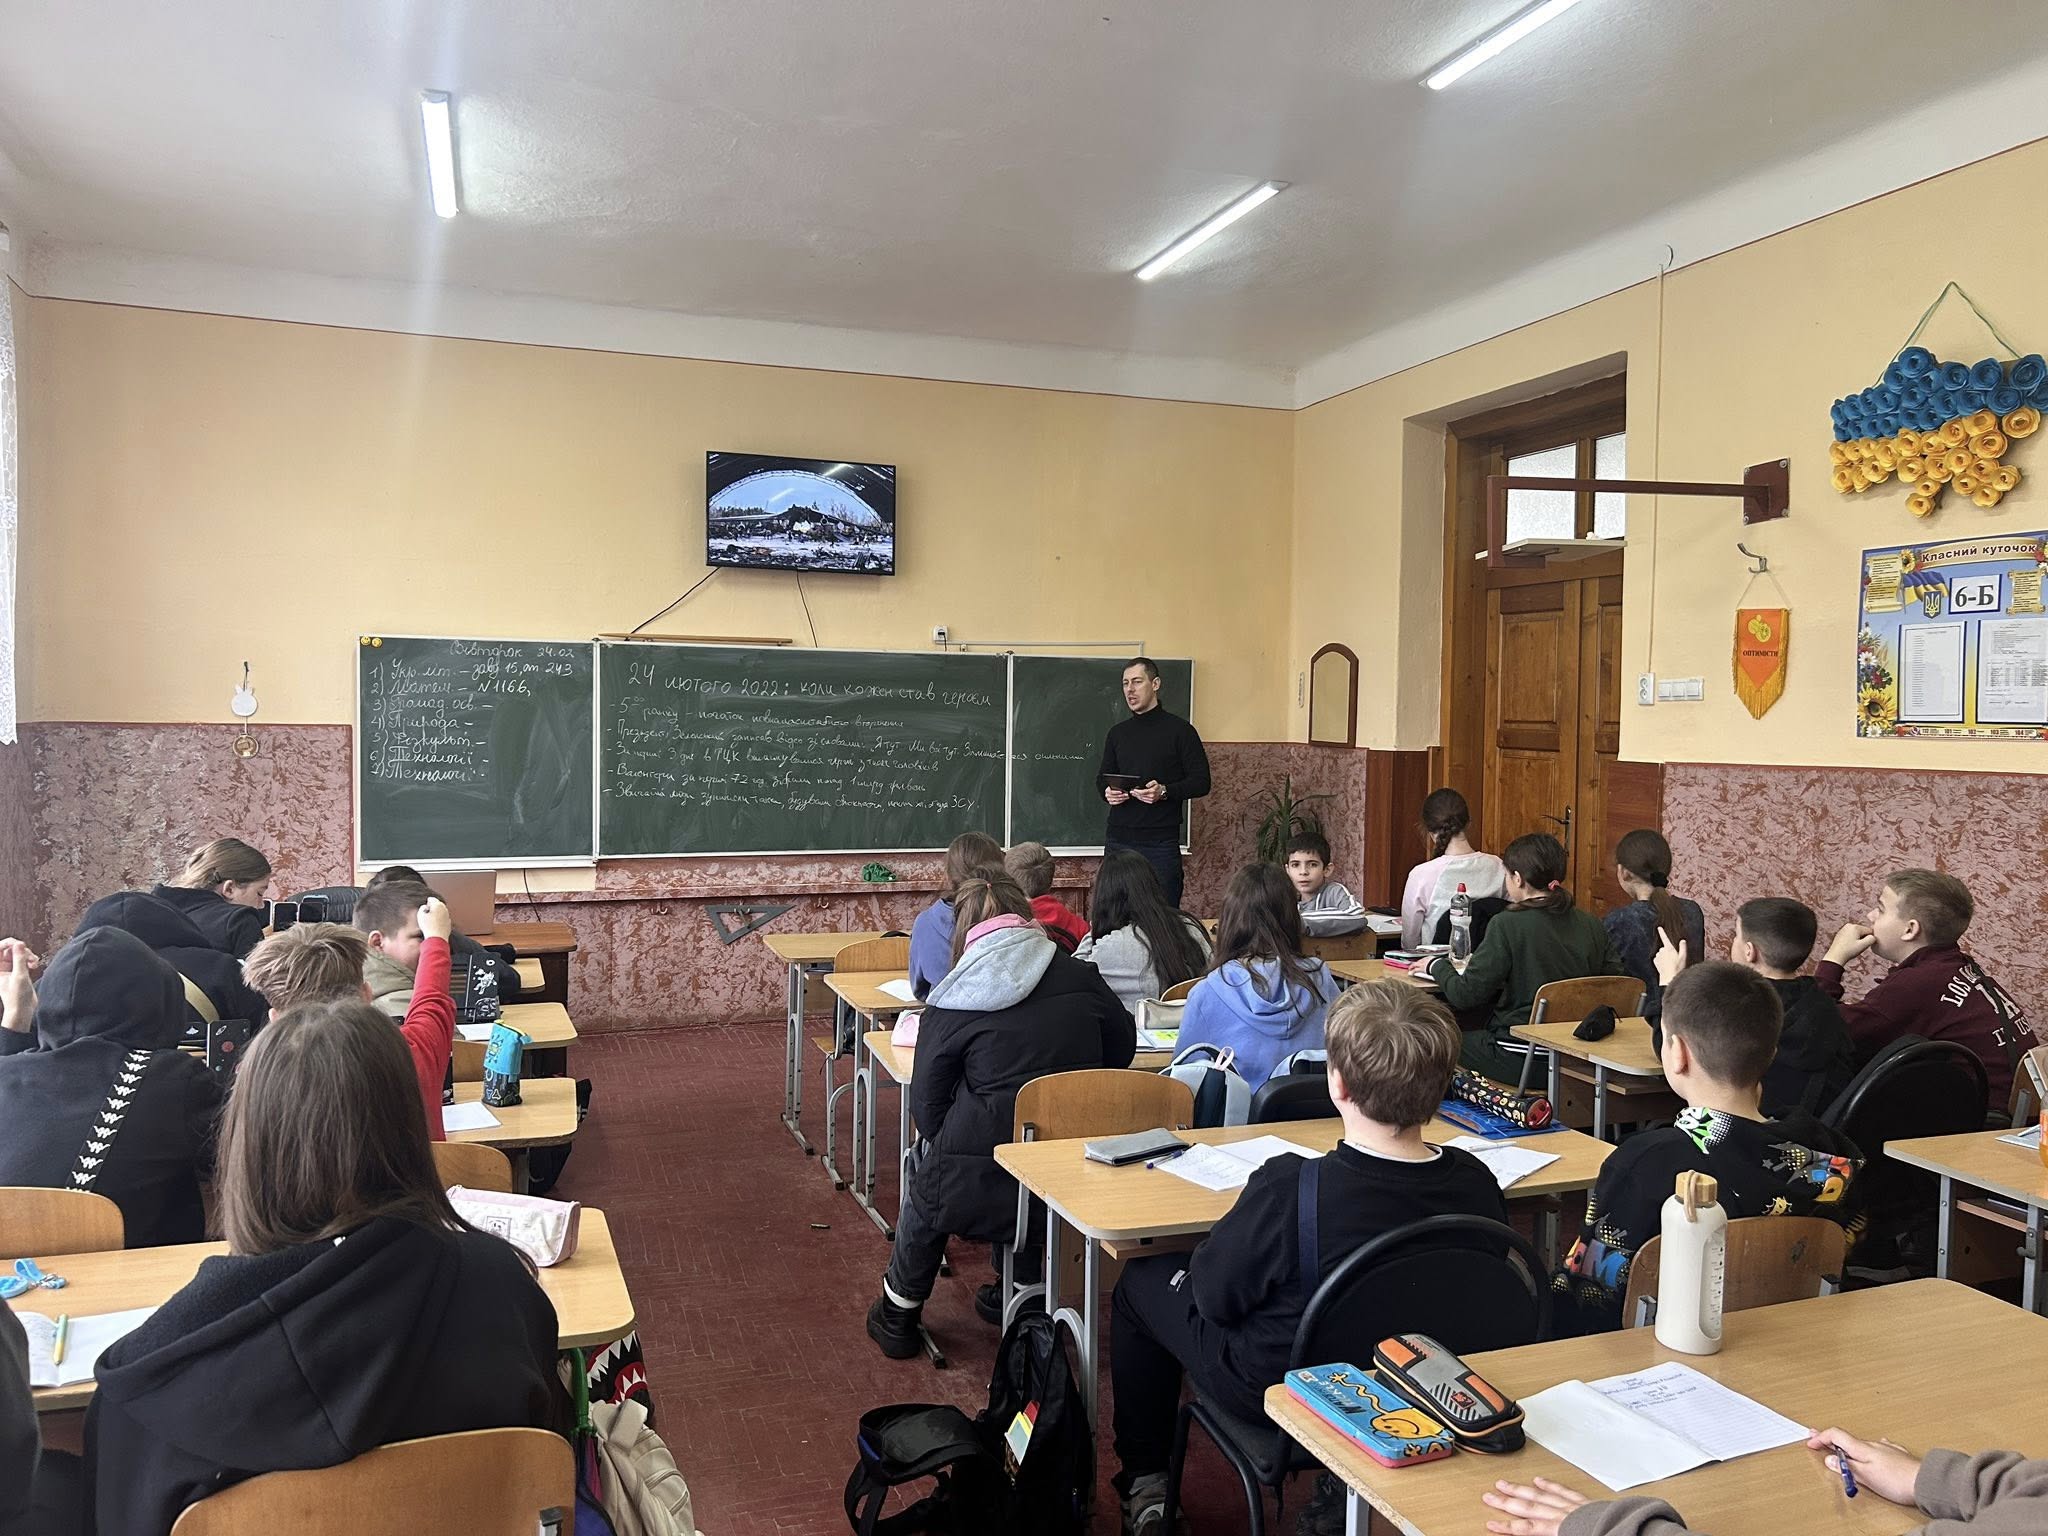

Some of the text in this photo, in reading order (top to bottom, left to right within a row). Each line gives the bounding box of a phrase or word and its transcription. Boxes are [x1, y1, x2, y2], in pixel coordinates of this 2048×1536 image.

[1921, 543, 2037, 563] Класний куточок
[1954, 584, 1995, 607] 6-Б
[536, 646, 575, 658] 24.02
[545, 662, 573, 677] 243
[629, 663, 655, 686] 24
[1940, 976, 1971, 1008] LOS
